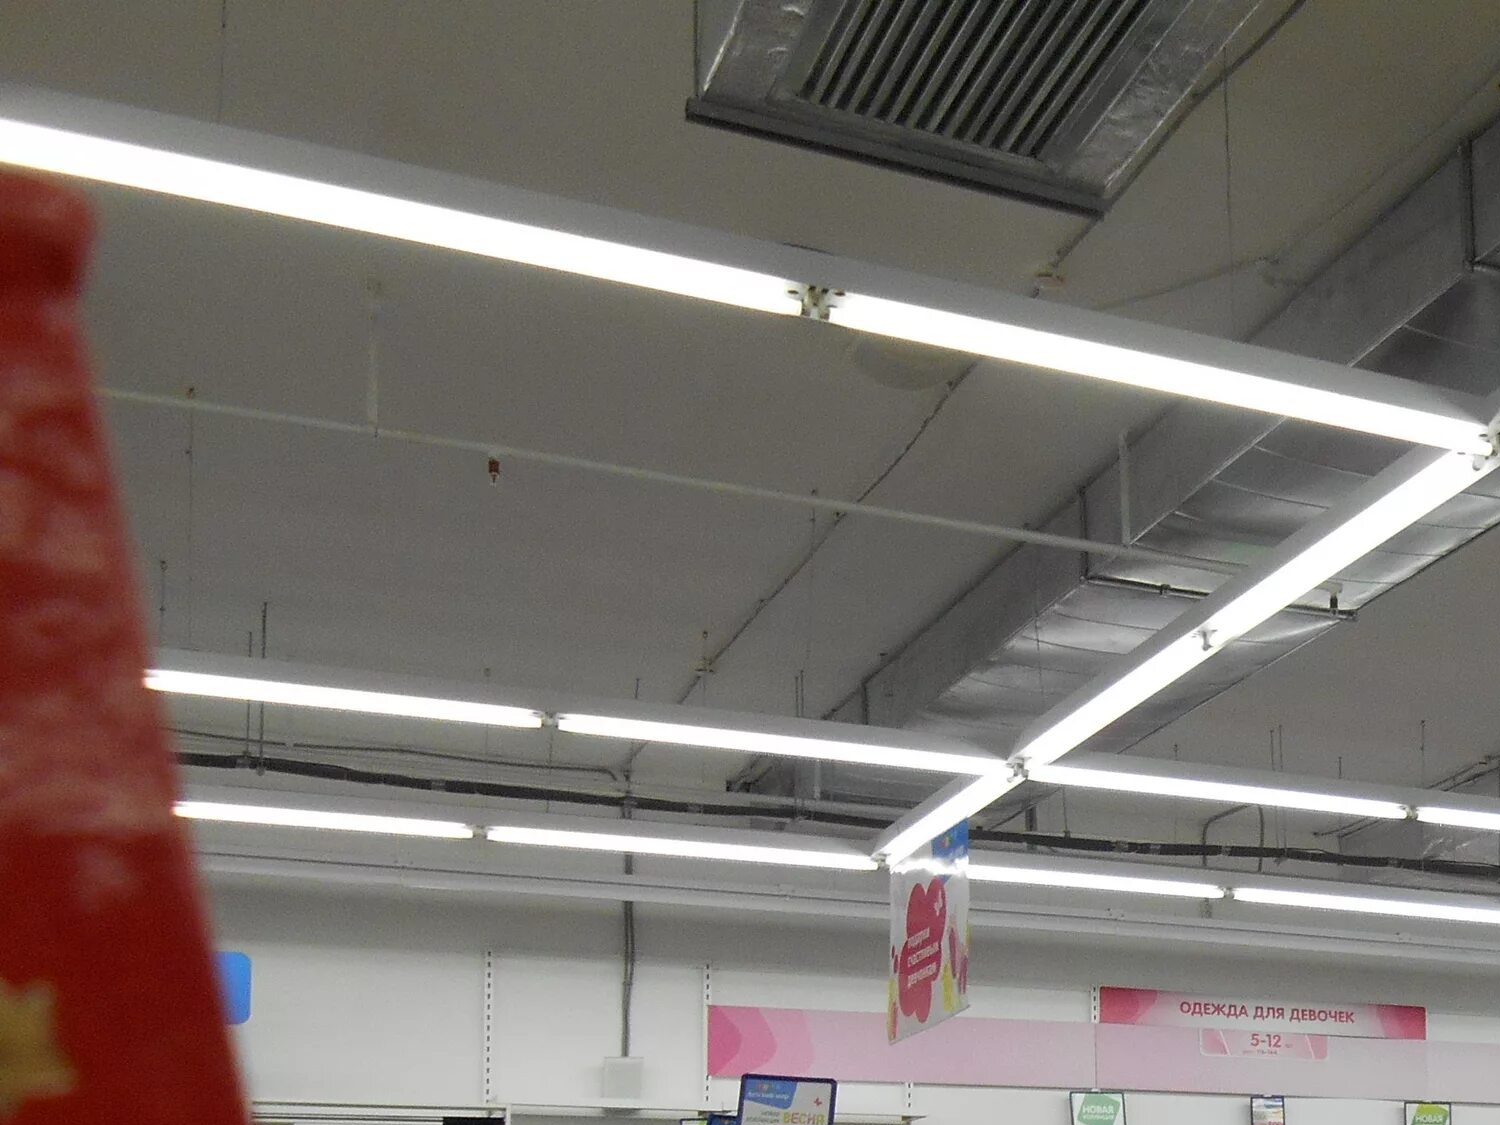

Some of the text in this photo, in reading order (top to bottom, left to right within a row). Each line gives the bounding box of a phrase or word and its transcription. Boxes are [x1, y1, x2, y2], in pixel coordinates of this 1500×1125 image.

[1180, 1001, 1355, 1024] ОДЕЖДА ДЛЯ ДЕВОЧЕК
[1250, 1033, 1282, 1049] 5-12
[1082, 1104, 1114, 1114] НОВАЯ
[1415, 1114, 1444, 1122] НОВАЯ
